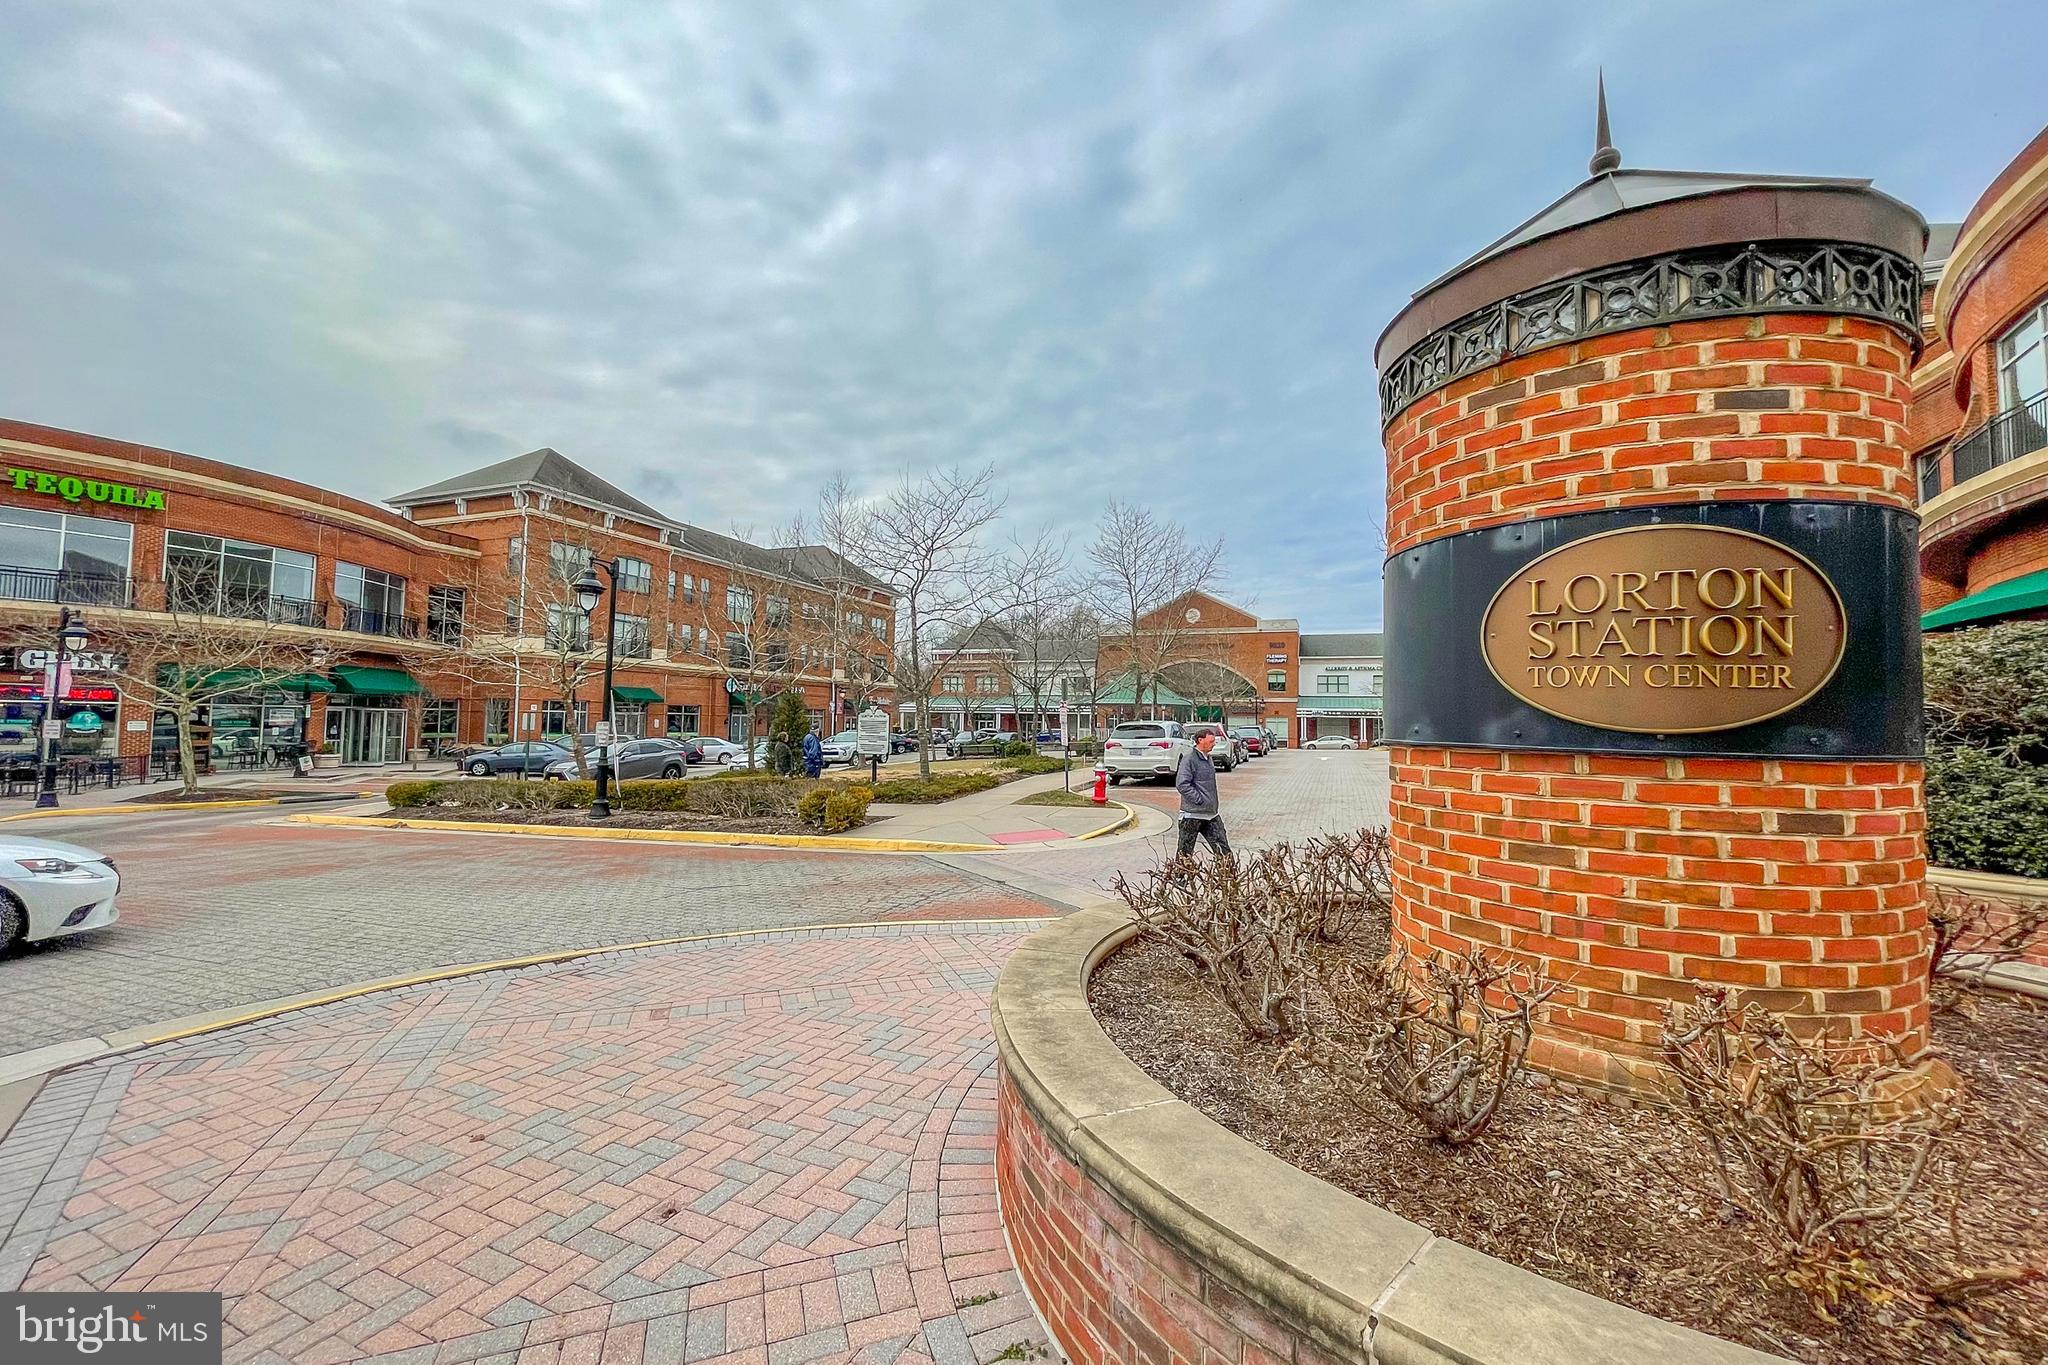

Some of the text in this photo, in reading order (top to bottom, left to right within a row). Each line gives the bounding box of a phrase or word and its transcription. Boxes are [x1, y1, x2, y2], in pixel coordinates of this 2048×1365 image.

[8, 467, 166, 511] TEQUILA
[1526, 566, 1799, 617] LORTON
[1527, 614, 1799, 660] STATION
[1527, 664, 1796, 689] TOWN CENTER
